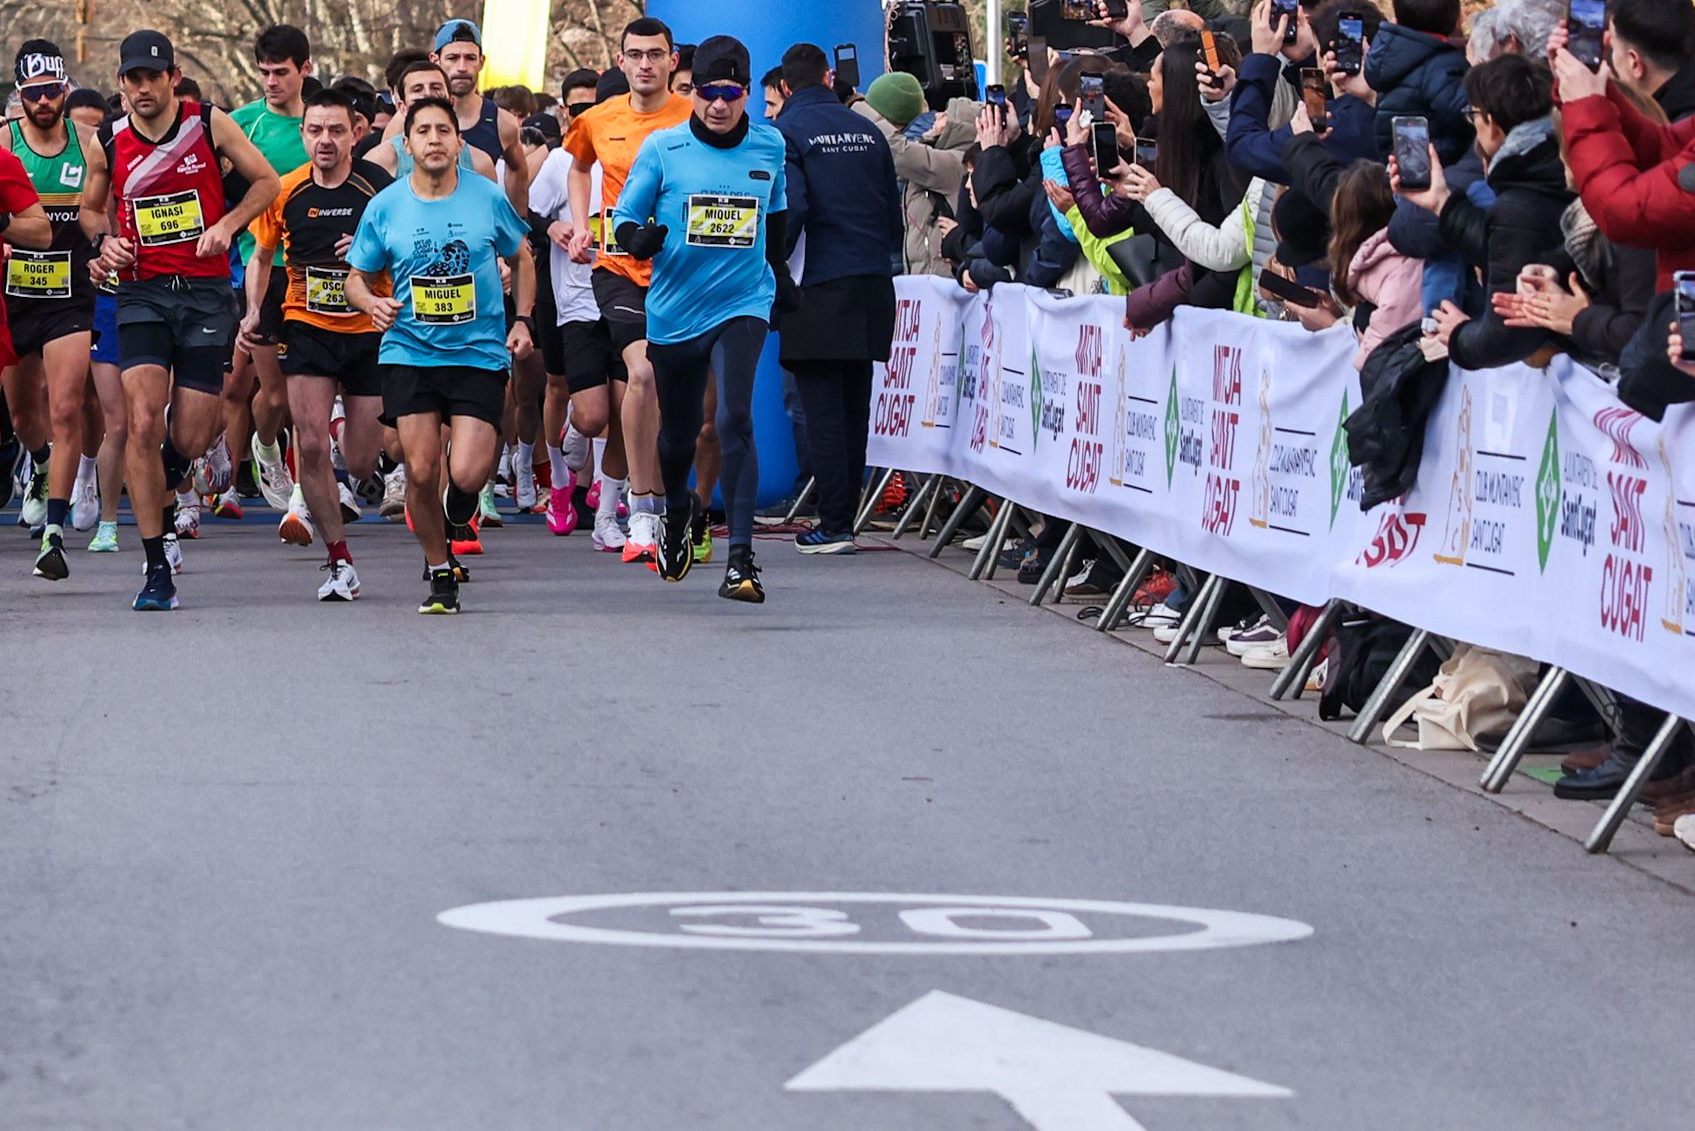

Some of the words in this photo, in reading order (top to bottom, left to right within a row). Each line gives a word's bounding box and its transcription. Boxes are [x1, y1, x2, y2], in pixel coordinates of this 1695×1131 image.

[808, 132, 876, 146] MUNTANYENC
[151, 206, 184, 219] IGNASI
[318, 208, 354, 217] INVERSE
[704, 209, 742, 221] MIQUEL
[160, 220, 179, 231] 696
[710, 223, 735, 234] 2622
[24, 263, 55, 274] ROGER
[30, 276, 48, 286] 345
[424, 288, 462, 300] MIGUEL
[434, 302, 453, 312] 383
[884, 346, 917, 390] SANT
[1075, 381, 1102, 436] SANT
[875, 392, 916, 438] CUGAT
[1066, 437, 1104, 495] CUGAT
[1600, 553, 1653, 643] CUGAT
[667, 903, 1094, 940] 30
